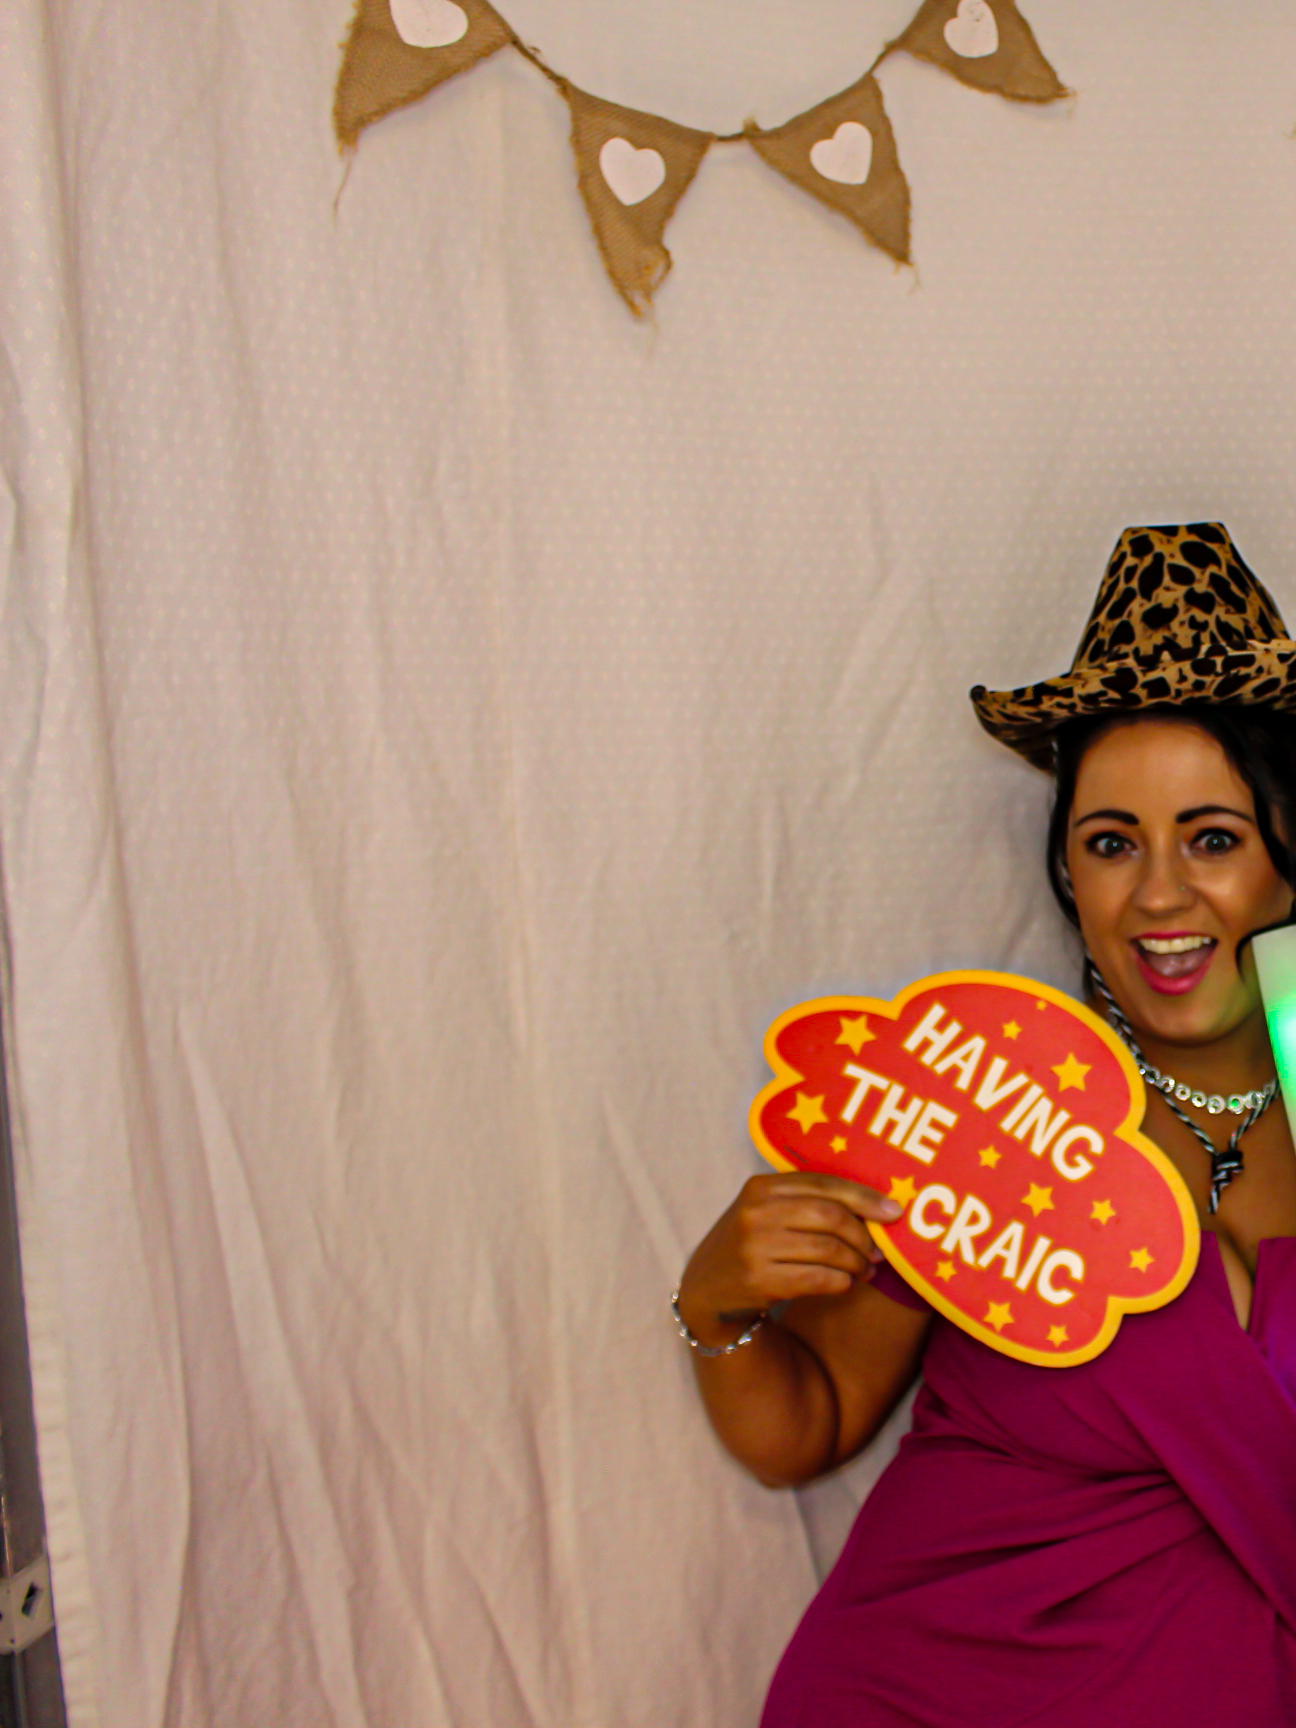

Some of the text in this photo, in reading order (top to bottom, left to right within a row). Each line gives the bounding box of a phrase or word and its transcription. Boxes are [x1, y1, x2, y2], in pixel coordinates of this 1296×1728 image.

[841, 1064, 958, 1164] THE
[903, 1002, 1105, 1181] HAVING
[909, 1183, 1085, 1305] CRAIC
